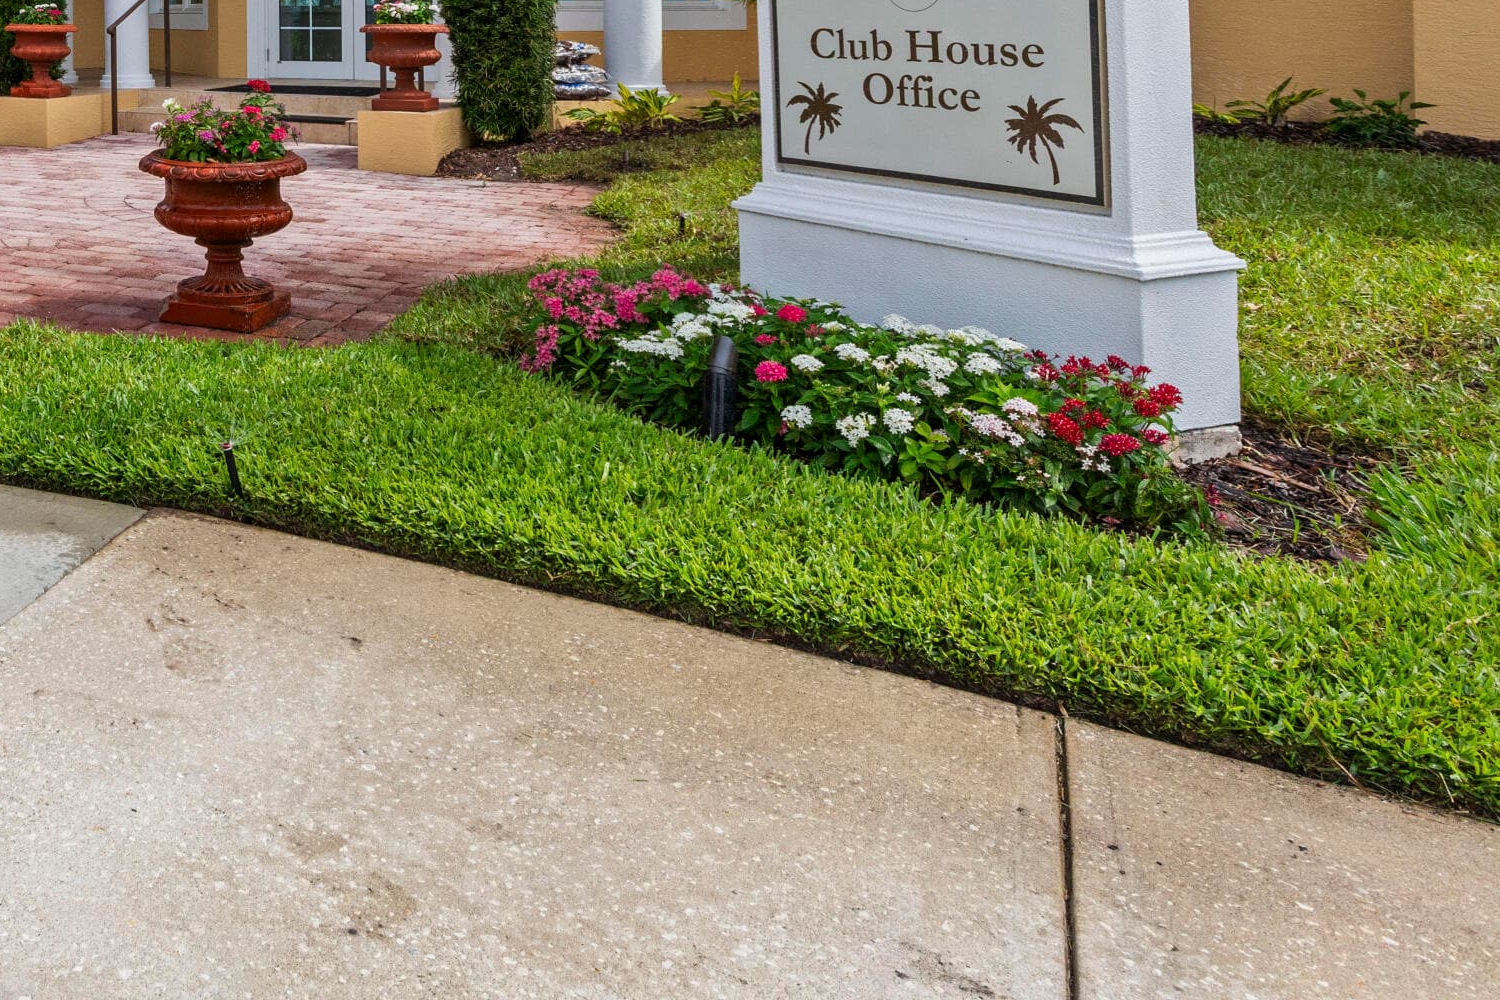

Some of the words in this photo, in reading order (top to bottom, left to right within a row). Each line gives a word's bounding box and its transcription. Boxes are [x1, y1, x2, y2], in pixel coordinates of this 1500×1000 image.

[809, 27, 893, 62] Club
[905, 29, 1045, 68] House
[862, 72, 981, 113] Office
